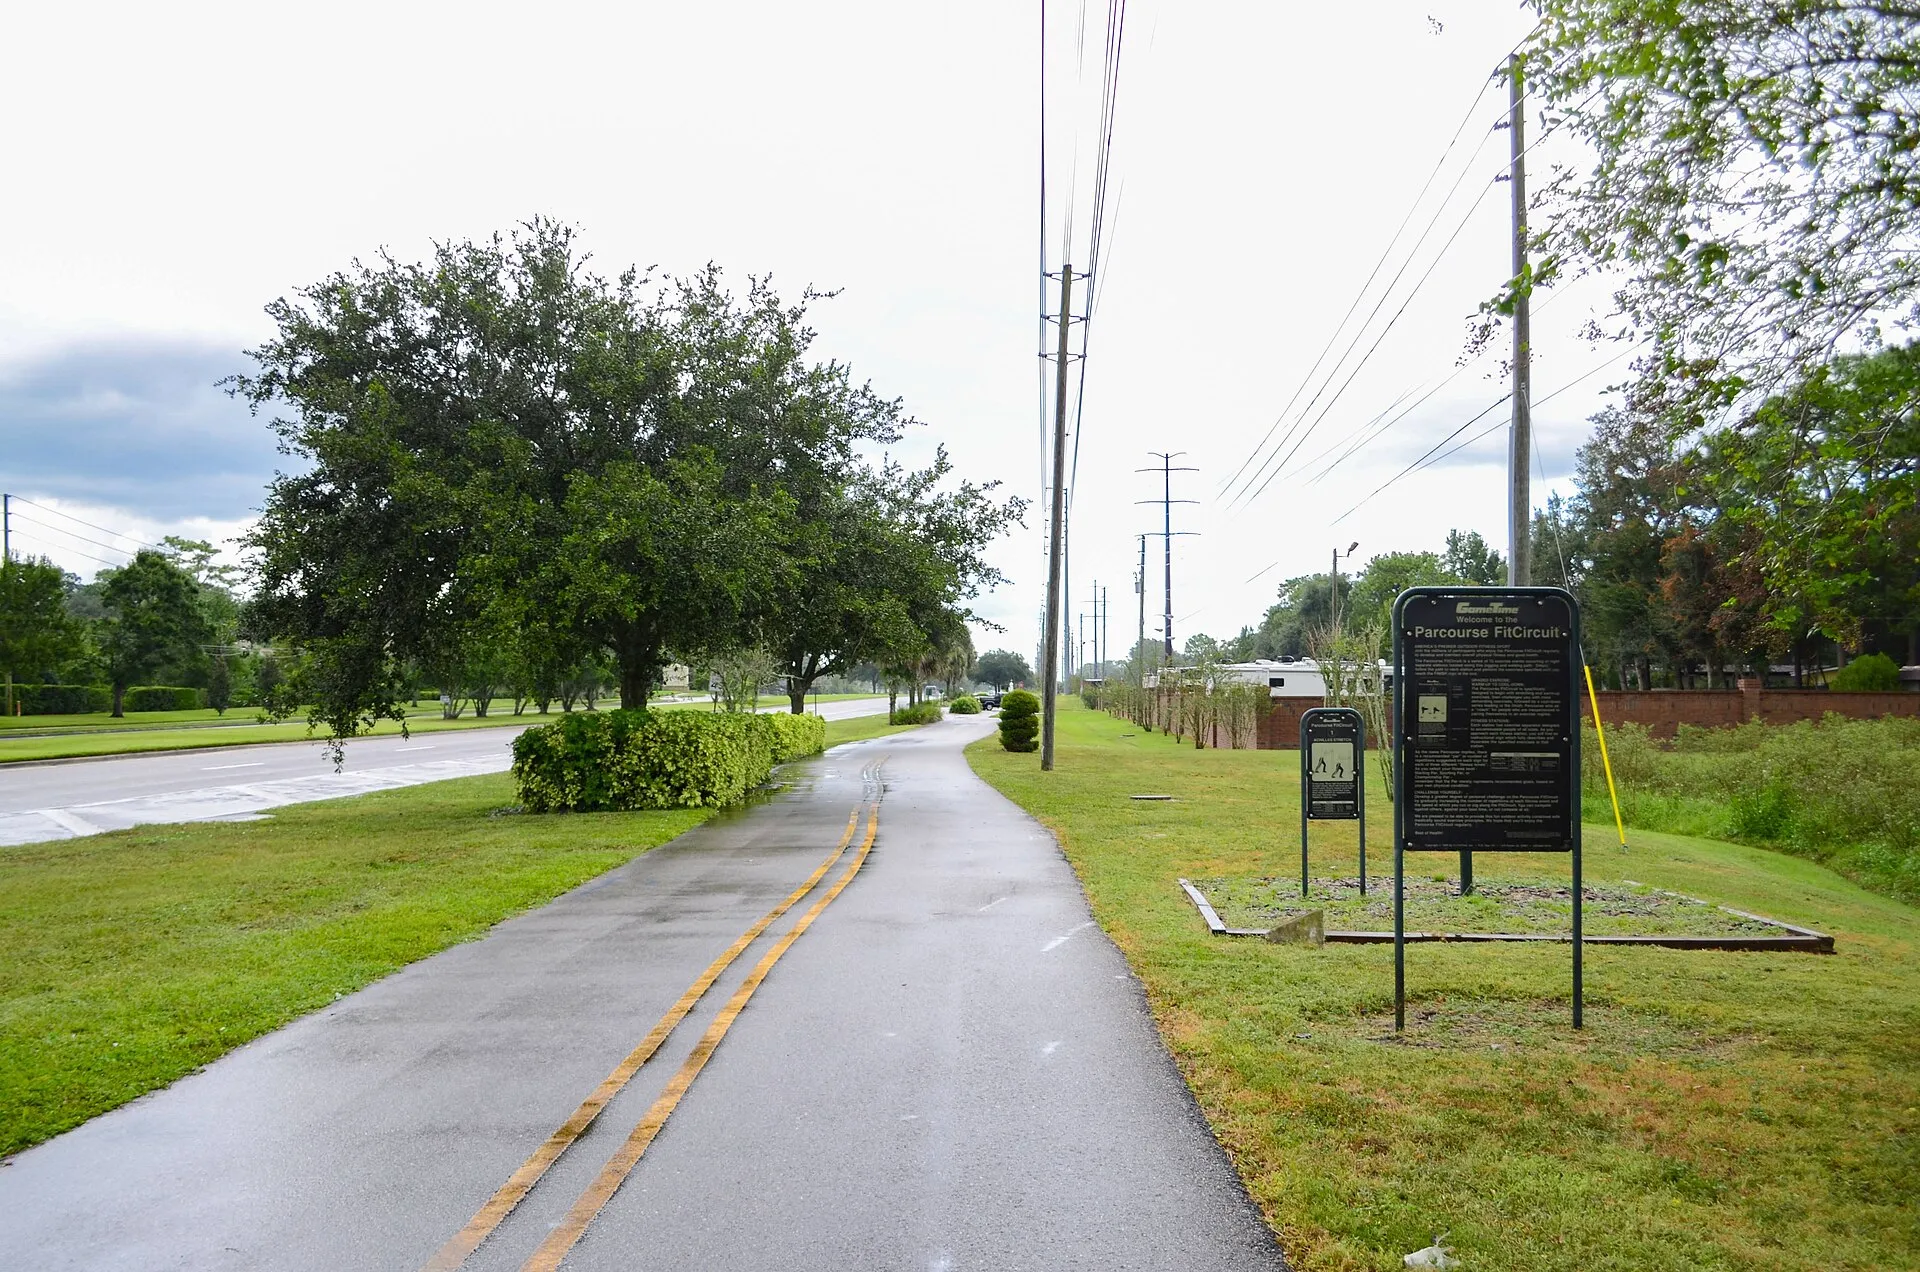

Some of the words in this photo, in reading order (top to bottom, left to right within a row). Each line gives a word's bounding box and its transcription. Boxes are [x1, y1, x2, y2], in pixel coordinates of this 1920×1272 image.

[1455, 602, 1520, 614] GameTime
[1415, 626, 1489, 638] Parcourse
[1494, 626, 1560, 638] FitCircuit
